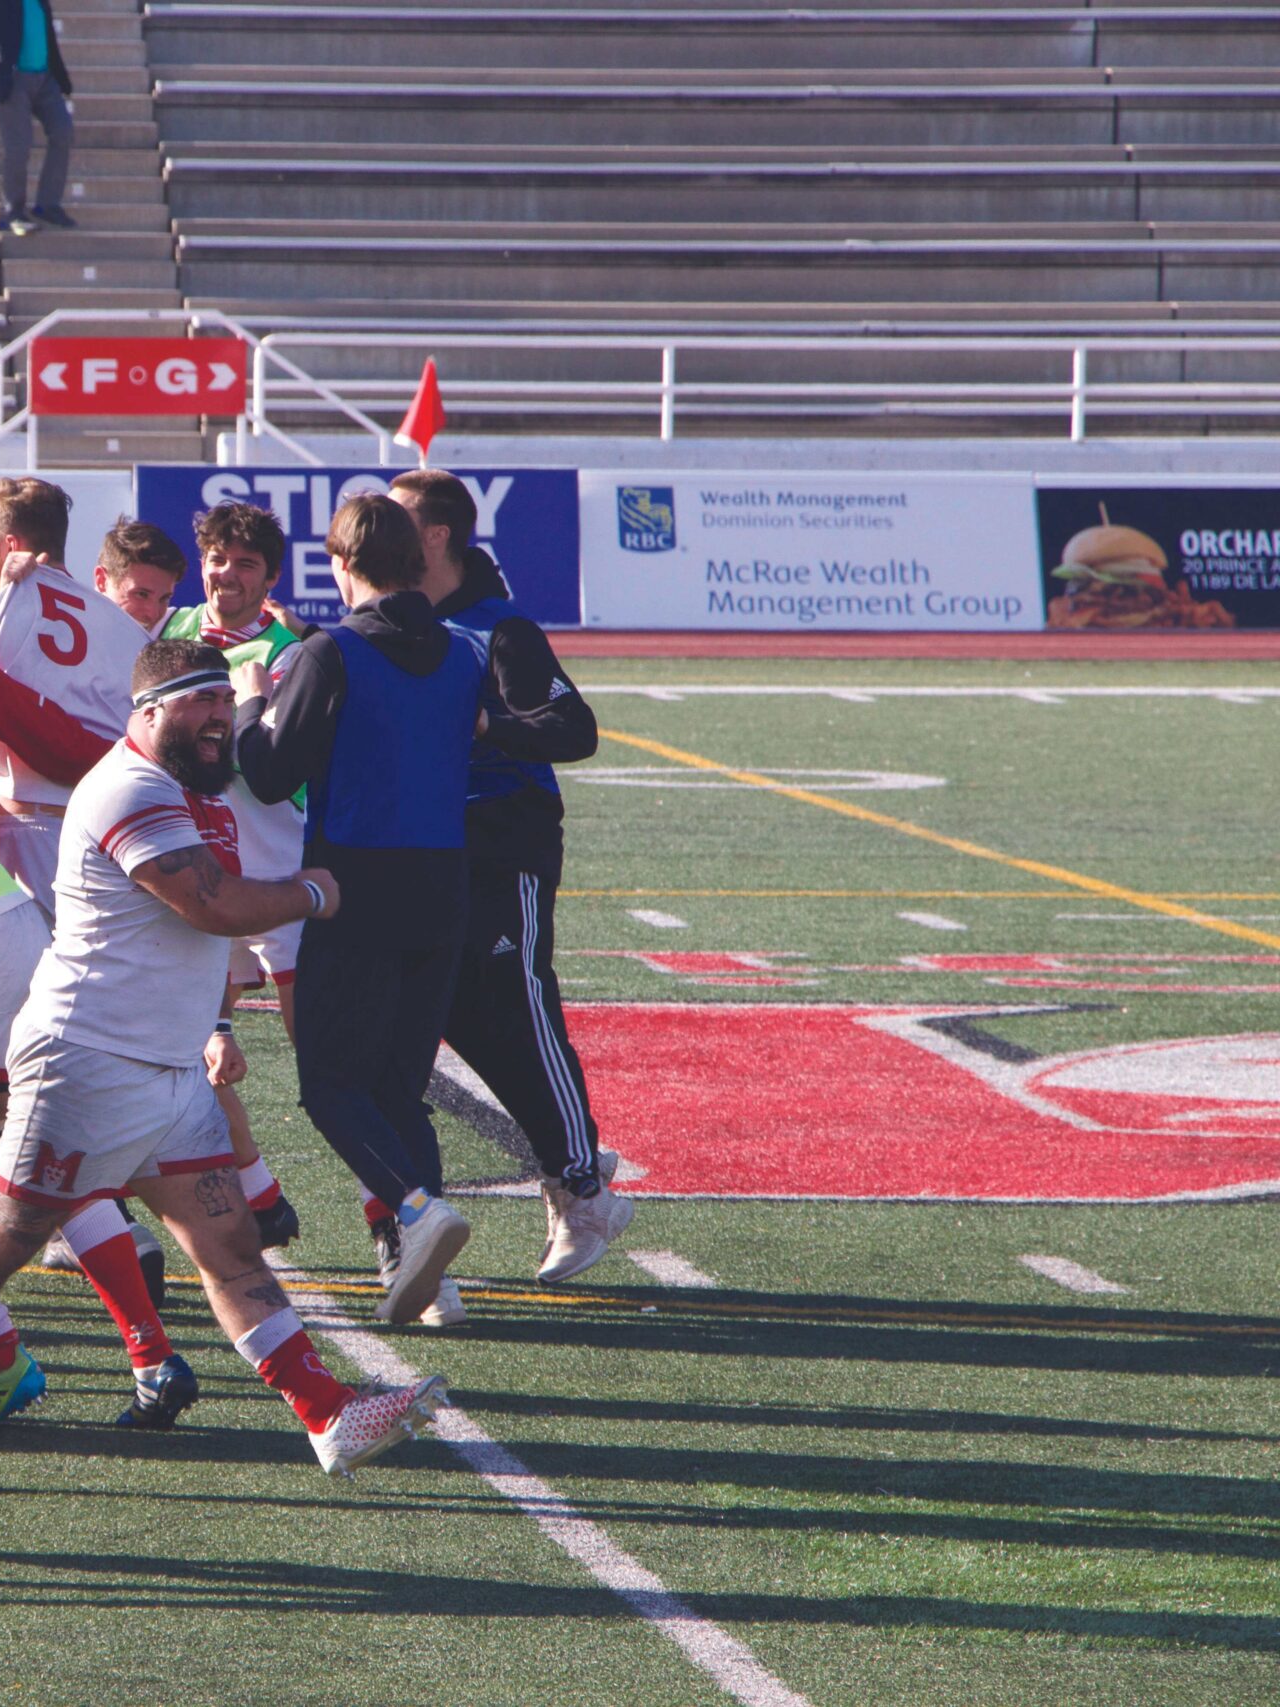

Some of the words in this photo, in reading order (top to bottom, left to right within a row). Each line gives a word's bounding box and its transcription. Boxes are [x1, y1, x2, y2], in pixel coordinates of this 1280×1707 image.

[82, 358, 118, 394] F
[155, 358, 197, 395] G
[700, 489, 770, 506] Wealth
[776, 491, 907, 511] Management
[702, 512, 793, 528] Dominion
[799, 512, 893, 529] Securities
[624, 532, 670, 548] RBC
[706, 560, 810, 584] McRae
[820, 559, 931, 585] Wealth
[708, 590, 915, 622] Management
[925, 591, 1022, 620] Group
[36, 582, 88, 667] 5
